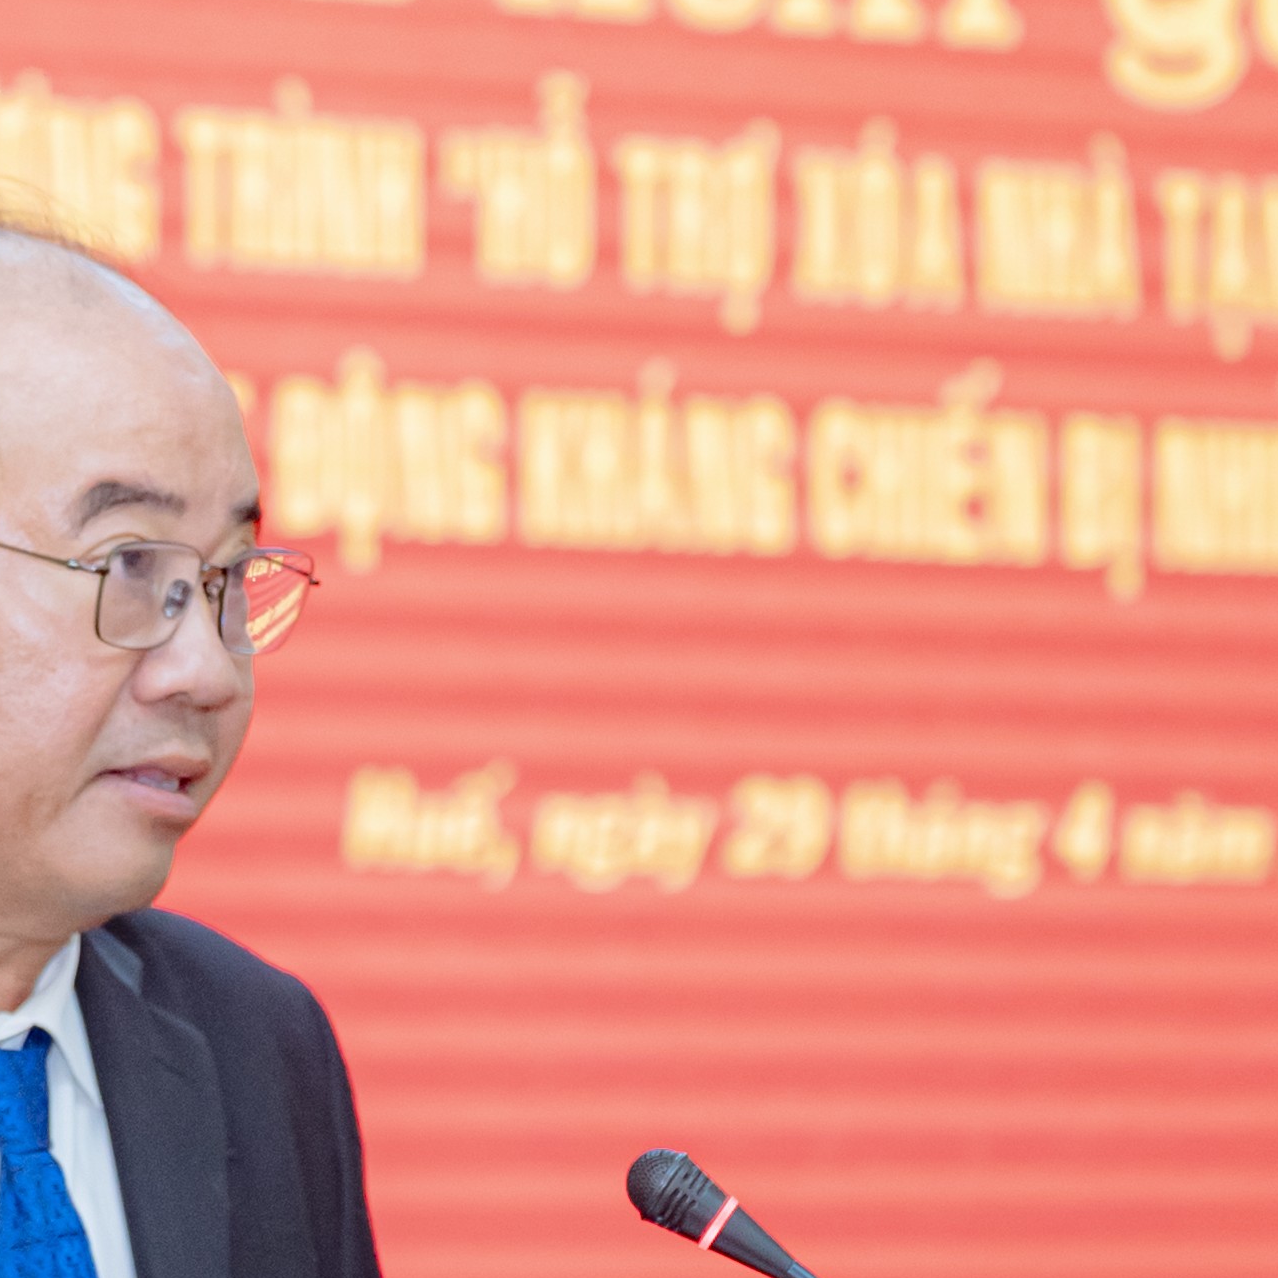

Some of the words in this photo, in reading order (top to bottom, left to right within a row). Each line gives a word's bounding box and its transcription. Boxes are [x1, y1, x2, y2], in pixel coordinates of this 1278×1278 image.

[177, 79, 423, 276] TRÌNH
[728, 778, 829, 877] 29
[1055, 781, 1110, 877] 4
